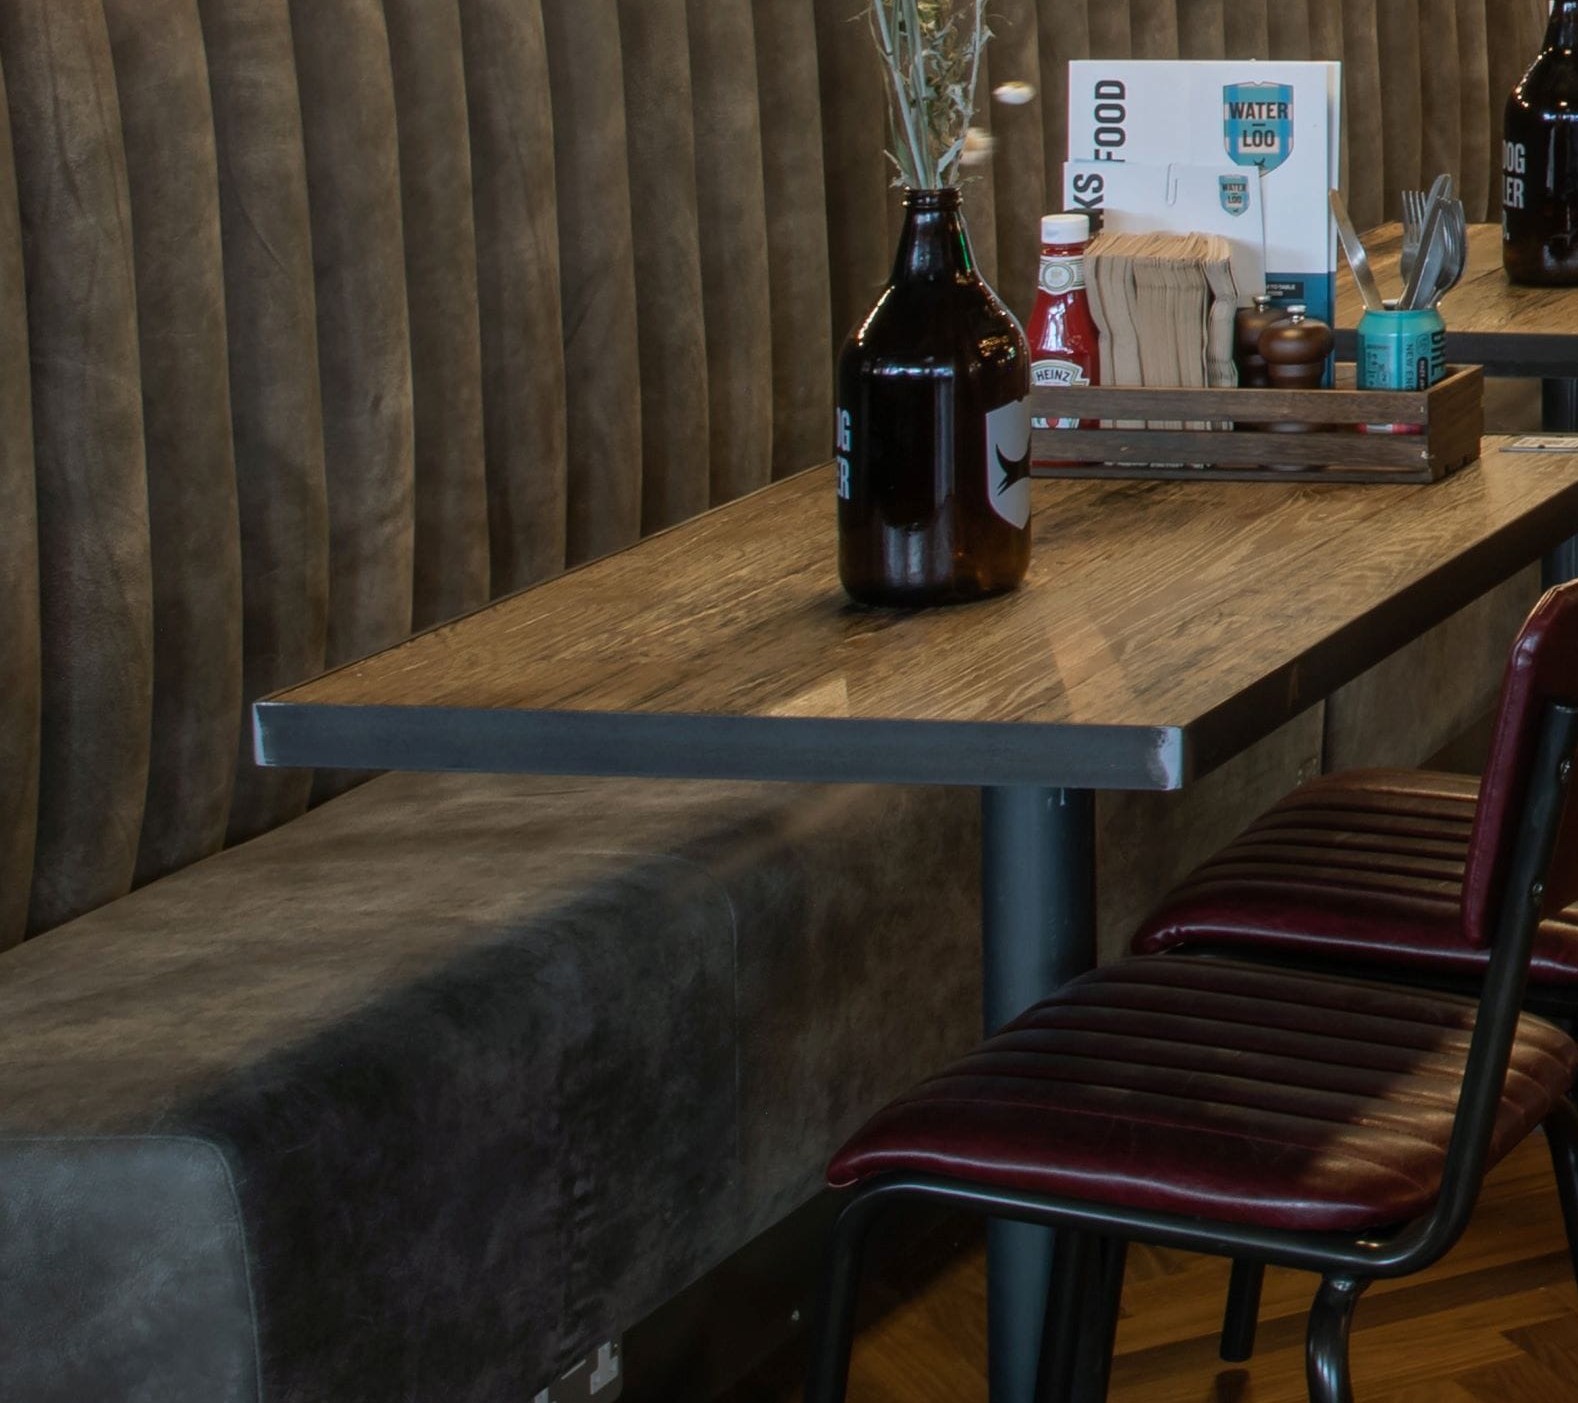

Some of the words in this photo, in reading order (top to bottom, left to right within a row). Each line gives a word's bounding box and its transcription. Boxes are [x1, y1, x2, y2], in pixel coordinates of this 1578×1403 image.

[1228, 101, 1289, 120] WATER
[1094, 80, 1126, 162] FOOD
[1242, 129, 1275, 148] LOO
[1222, 183, 1247, 192] WATER
[1227, 195, 1242, 204] LOO
[1035, 367, 1072, 383] HEINZ
